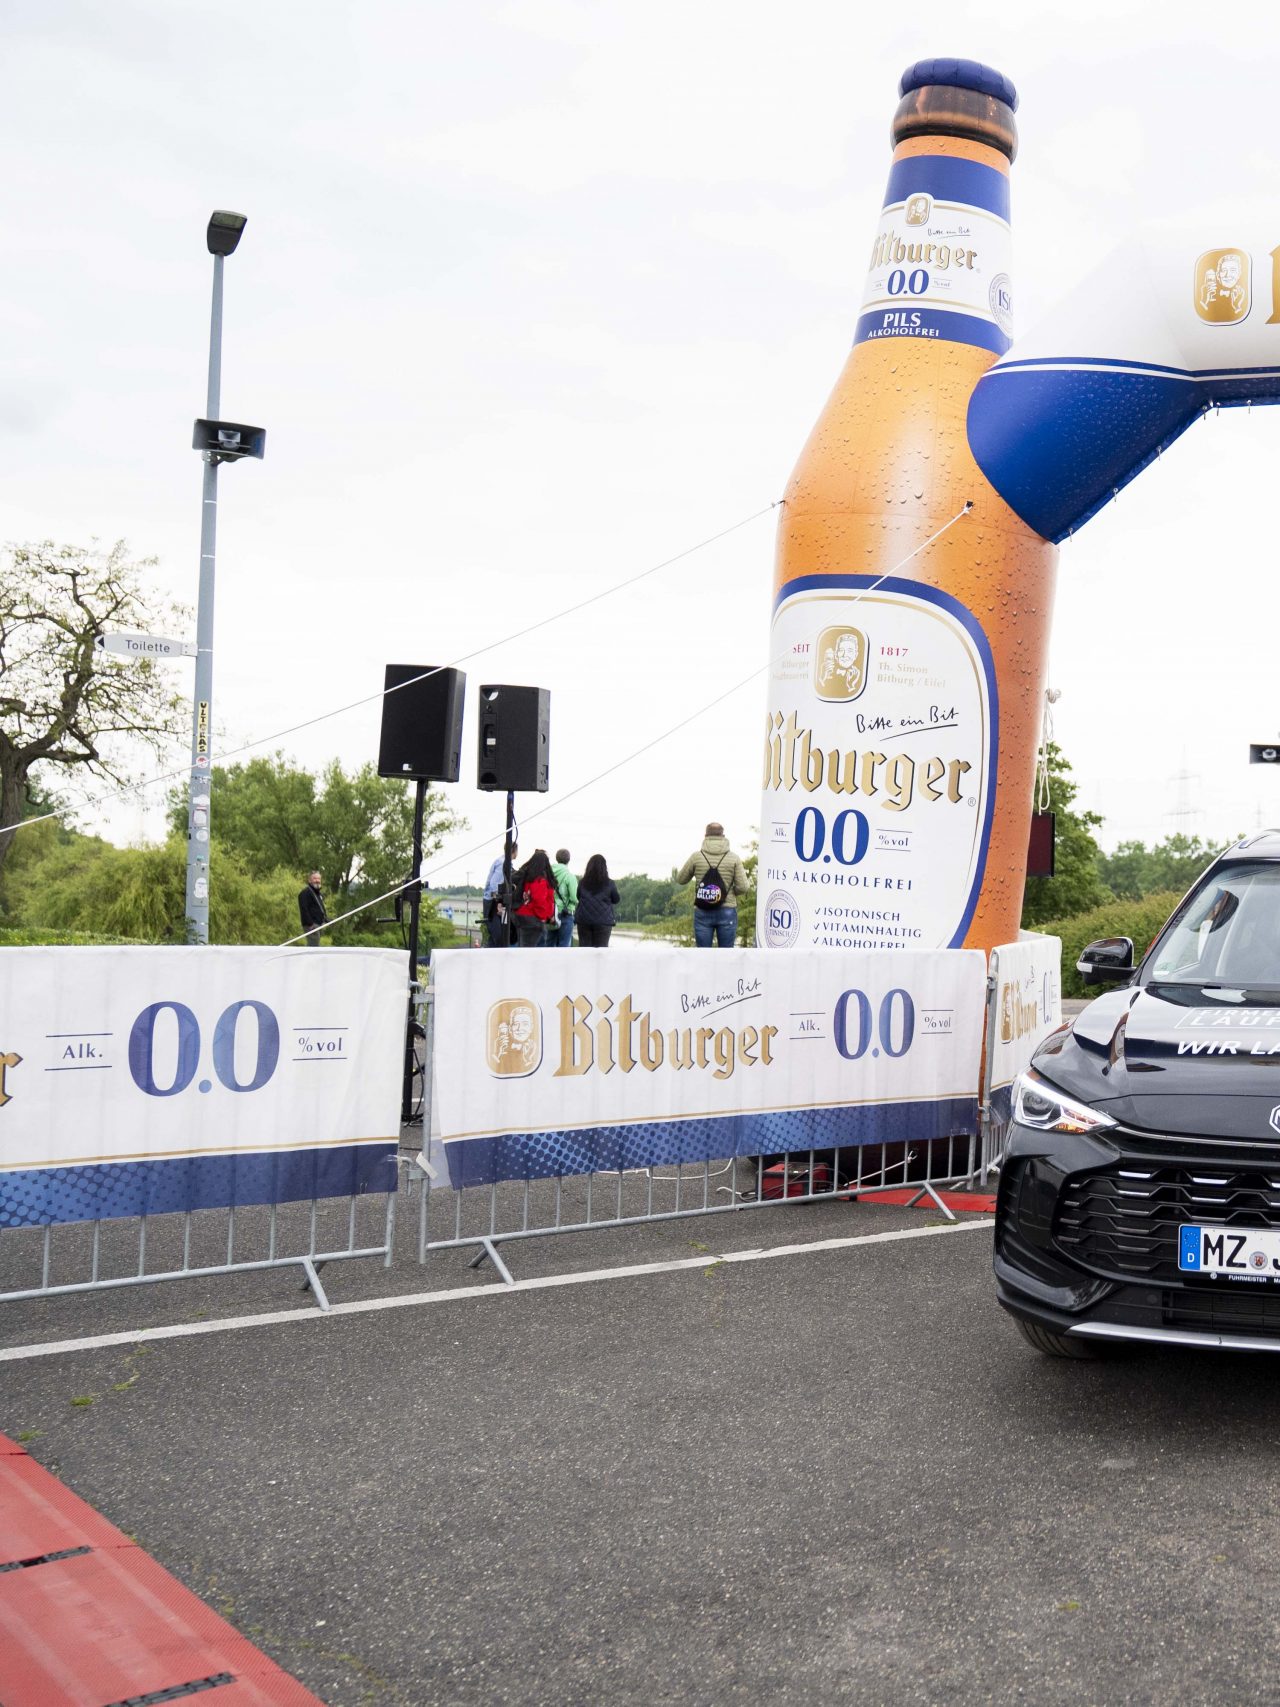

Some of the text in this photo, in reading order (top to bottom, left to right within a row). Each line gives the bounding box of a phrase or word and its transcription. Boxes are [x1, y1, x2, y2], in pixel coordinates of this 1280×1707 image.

[887, 269, 930, 295] 0.0
[883, 312, 922, 328] PILS
[868, 328, 940, 339] ALKOHOLFREI
[125, 640, 171, 653] Toilette
[880, 646, 909, 657] 1817
[897, 663, 929, 674] Simon
[877, 674, 914, 687] Bitburg
[856, 706, 959, 734] Bitte ein Bit
[794, 806, 870, 866] 0.0
[768, 868, 912, 891] PILS ALKOHOLFREI
[770, 908, 792, 930] ISO
[824, 907, 900, 922] ISOTONISCH
[823, 922, 922, 938] VITAMINHALTIG
[681, 978, 762, 1013] Bitte ein Bit
[552, 994, 779, 1080] Bitburger
[798, 1018, 820, 1032] Alk.
[833, 988, 915, 1060] 0.0
[62, 1042, 104, 1060] Alk.
[128, 1000, 280, 1097] 0.0
[1178, 1040, 1243, 1055] WIR
[1187, 1252, 1195, 1263] D
[1203, 1234, 1247, 1269] MZ
[1228, 1274, 1267, 1283] FUHRMEISTER
